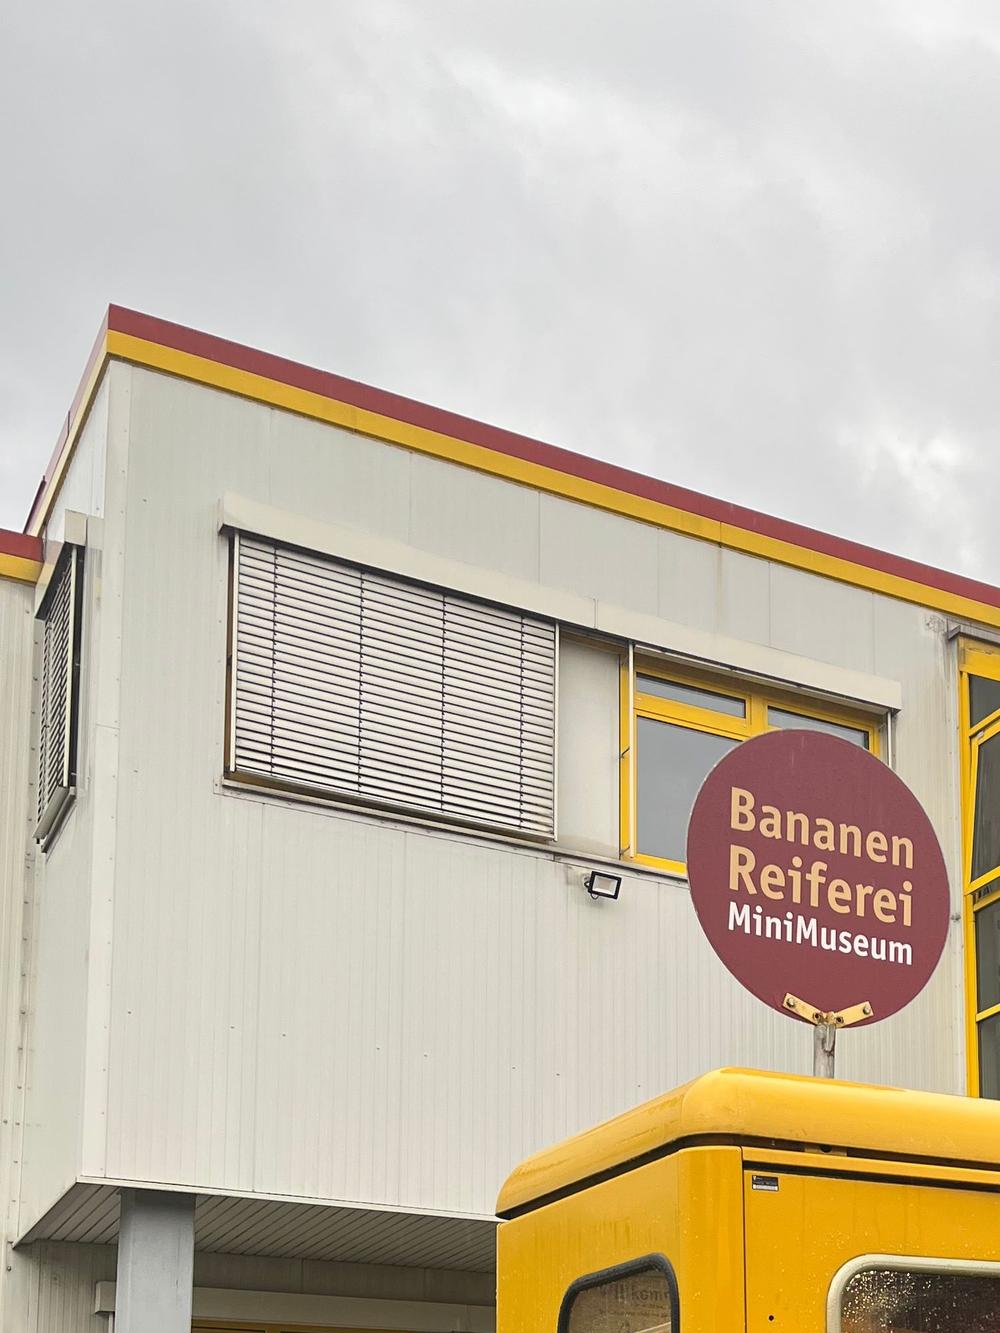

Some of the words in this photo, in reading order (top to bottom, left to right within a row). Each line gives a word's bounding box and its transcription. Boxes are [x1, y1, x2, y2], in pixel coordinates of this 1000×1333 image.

[730, 786, 914, 869] Bananen
[729, 844, 912, 927] Reiferei
[728, 901, 913, 966] MiniMuseum
